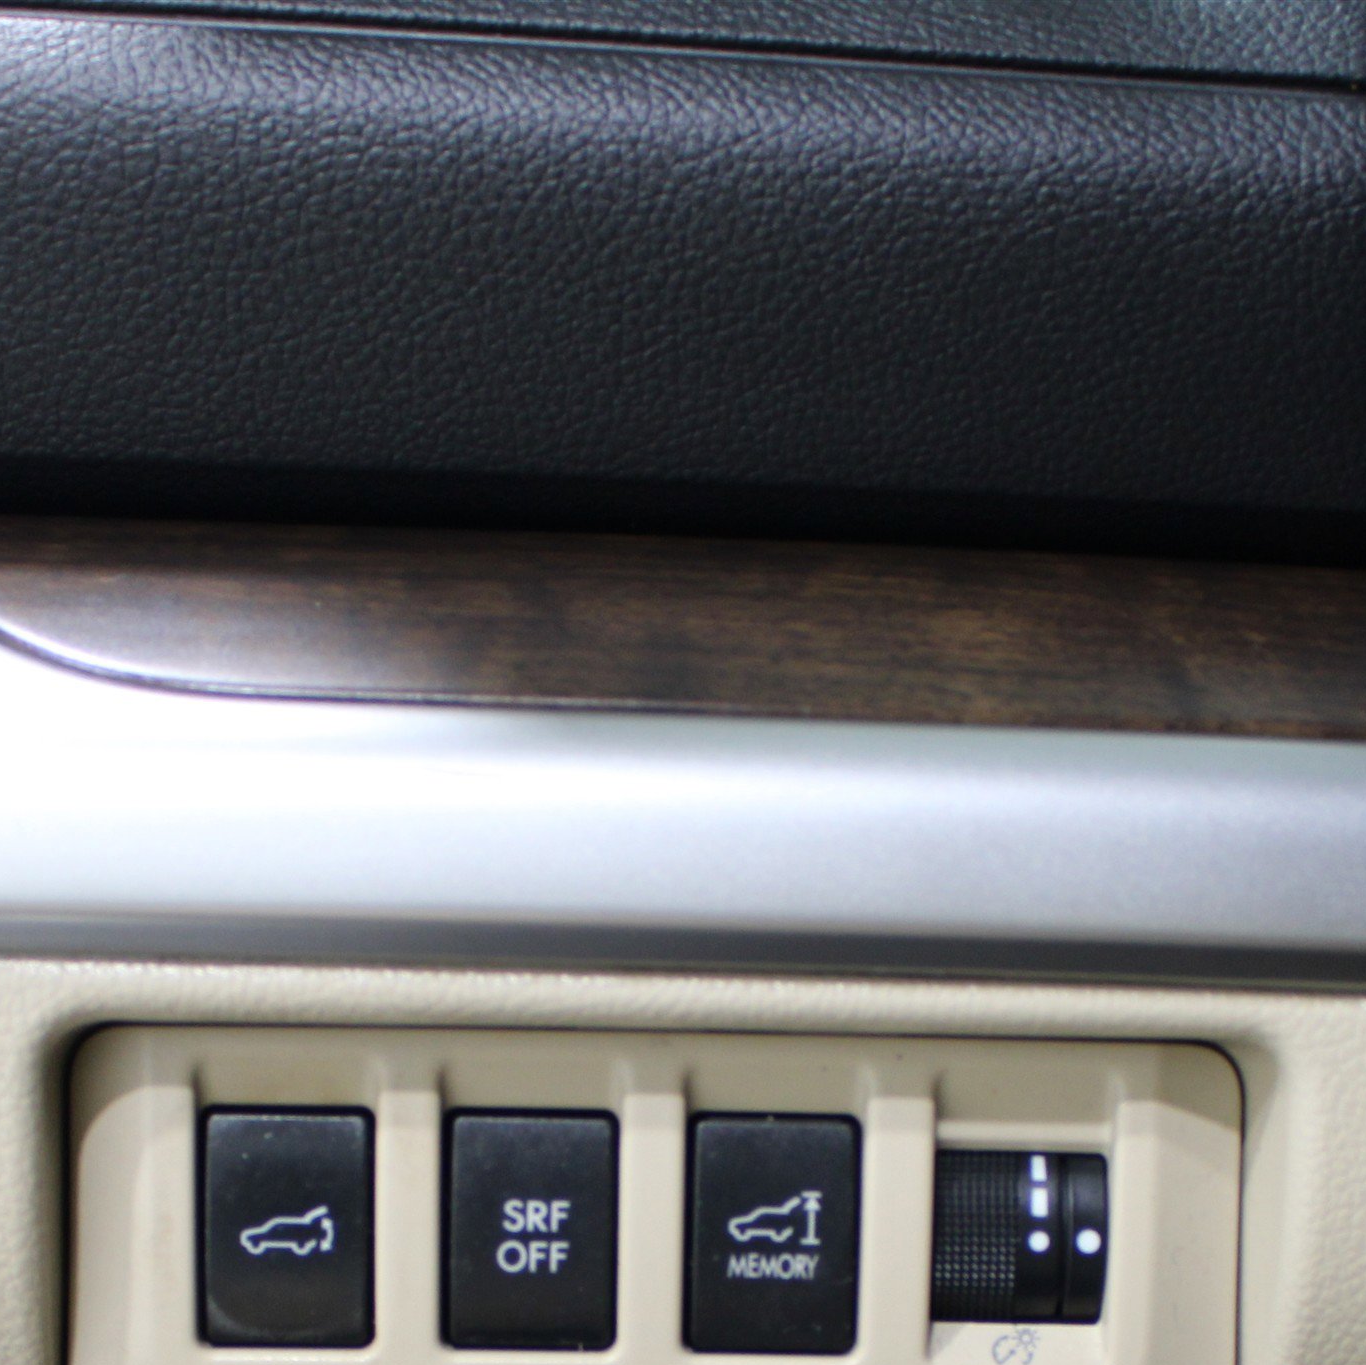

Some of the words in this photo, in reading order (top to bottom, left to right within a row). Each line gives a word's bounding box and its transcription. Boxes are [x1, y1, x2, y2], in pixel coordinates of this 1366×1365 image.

[502, 1198, 571, 1233] SRF
[496, 1239, 570, 1273] OFF
[727, 1252, 820, 1280] MEMORY
